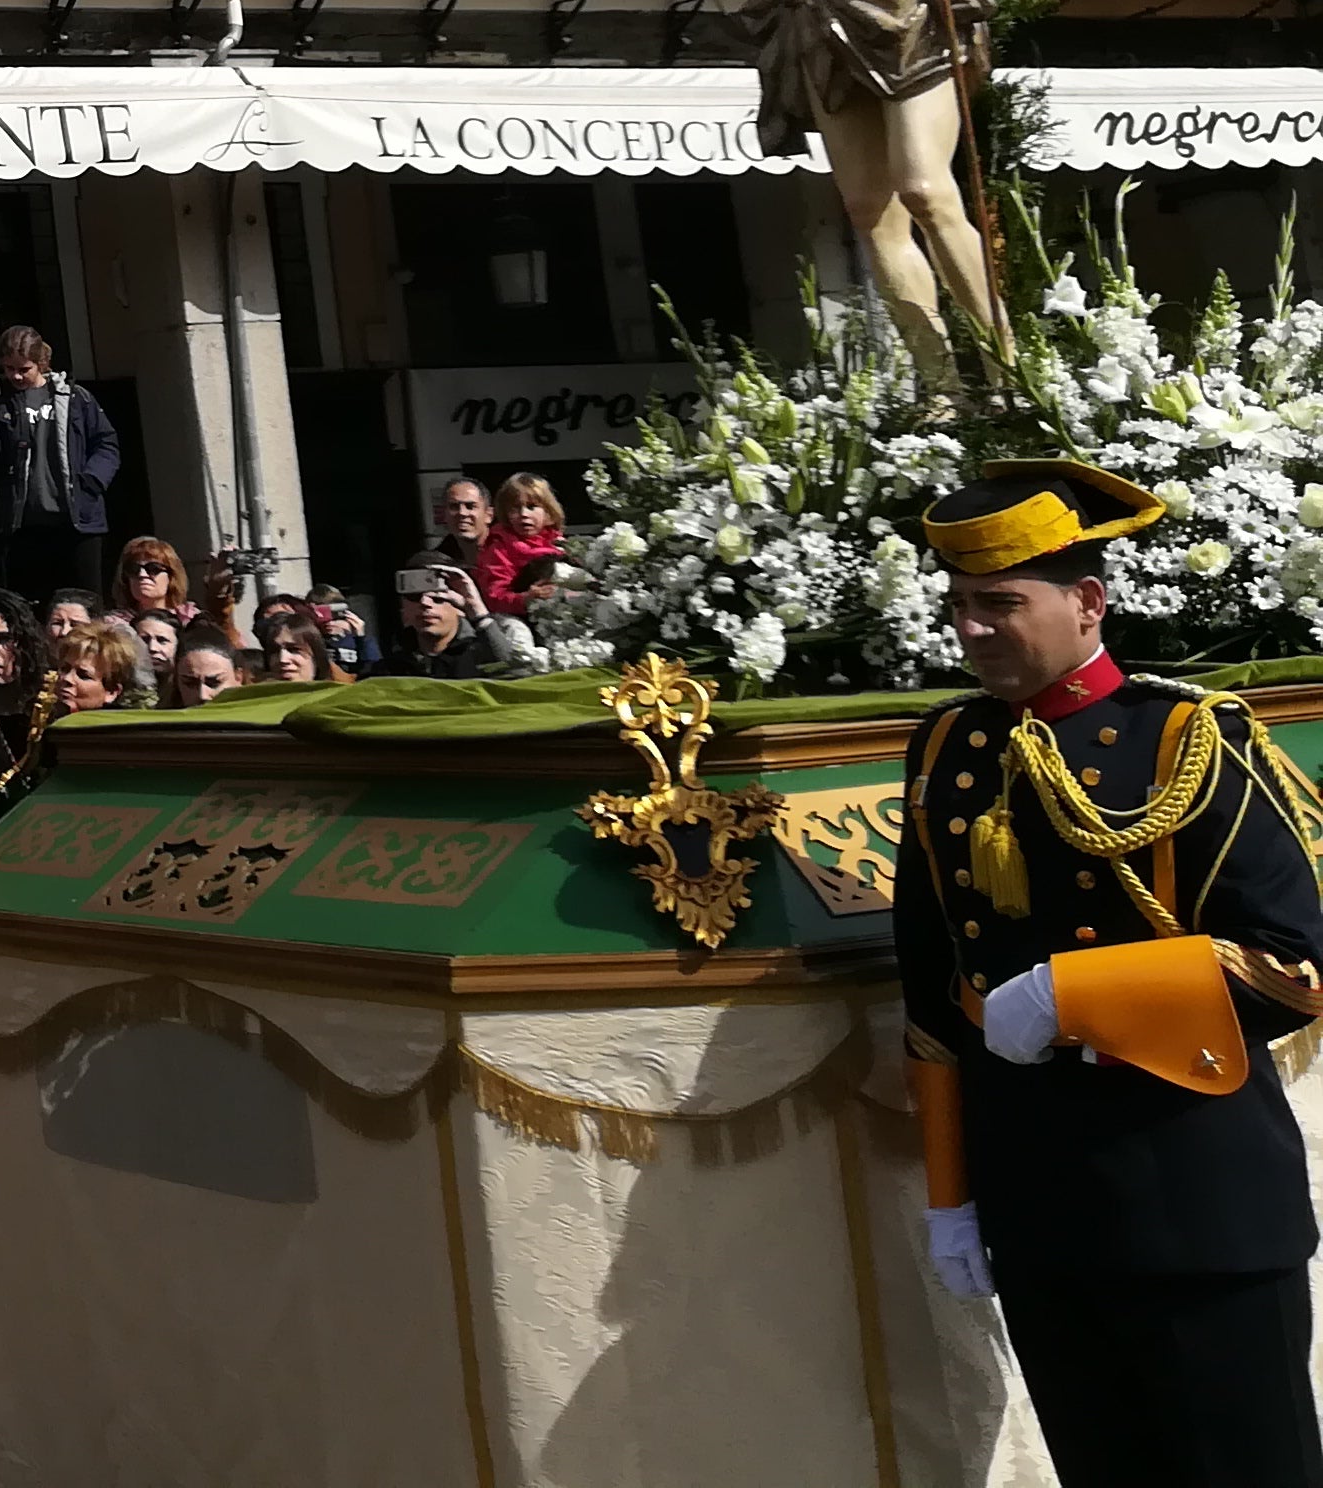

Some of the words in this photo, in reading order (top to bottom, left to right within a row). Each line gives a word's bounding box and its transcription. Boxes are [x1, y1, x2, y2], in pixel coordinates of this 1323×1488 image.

[370, 116, 446, 158] LA
[457, 108, 815, 162] CONCEPCIÓ
[1093, 104, 1323, 159] negresc
